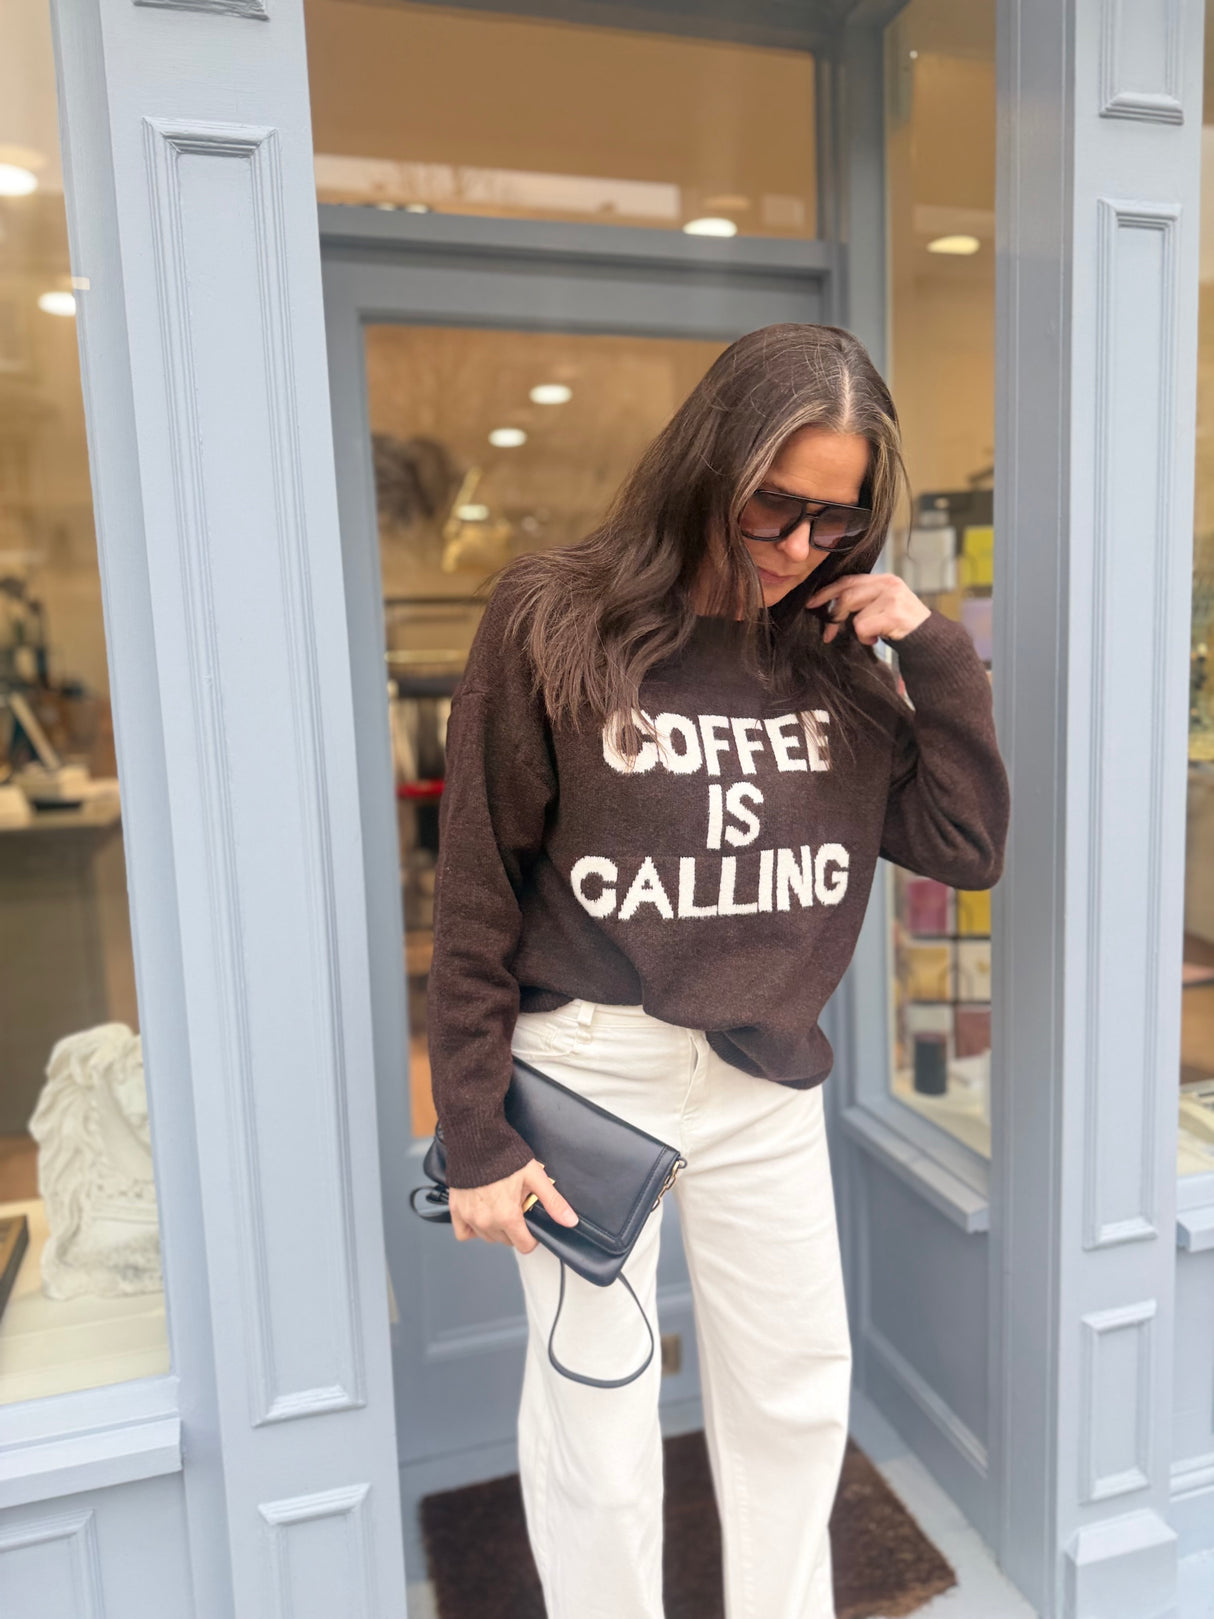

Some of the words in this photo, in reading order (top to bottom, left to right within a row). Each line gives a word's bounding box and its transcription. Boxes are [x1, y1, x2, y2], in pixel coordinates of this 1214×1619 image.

[602, 708, 831, 776] COFFEE
[706, 781, 764, 850] IS
[570, 843, 850, 920] CALLING
